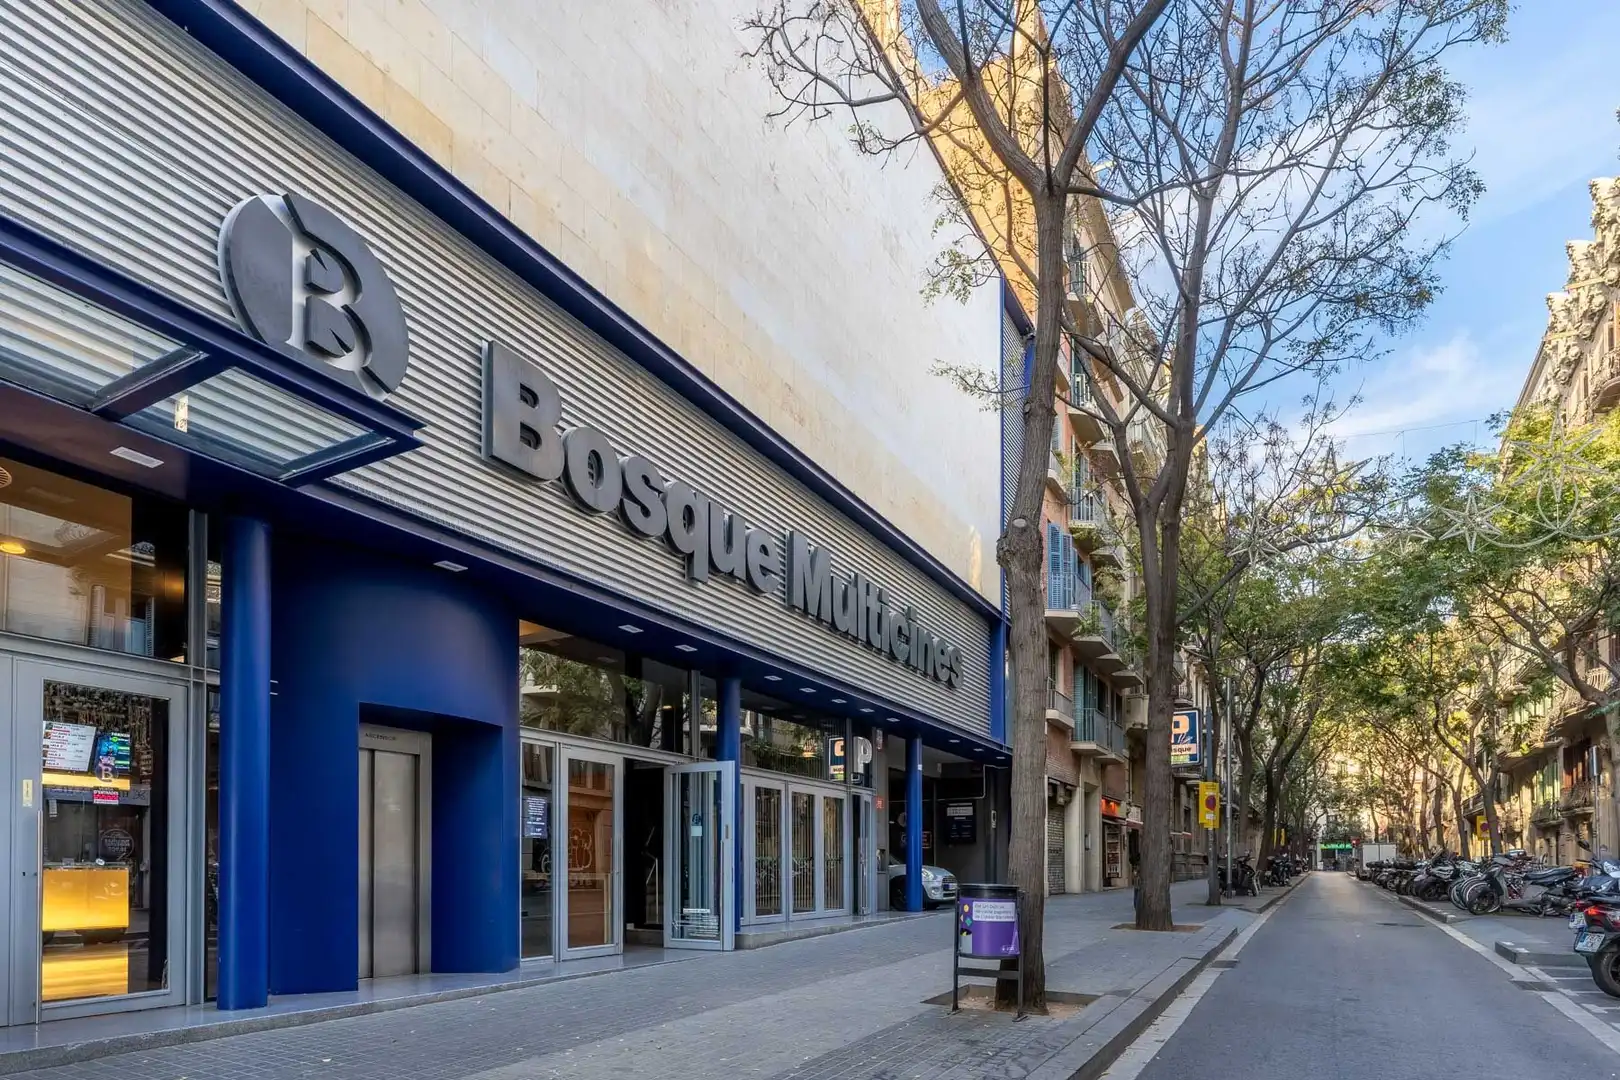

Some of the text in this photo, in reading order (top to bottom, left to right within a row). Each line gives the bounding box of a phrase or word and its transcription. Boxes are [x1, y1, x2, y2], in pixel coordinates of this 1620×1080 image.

[482, 339, 964, 691] Bosque Multicines
[853, 736, 873, 774] P
